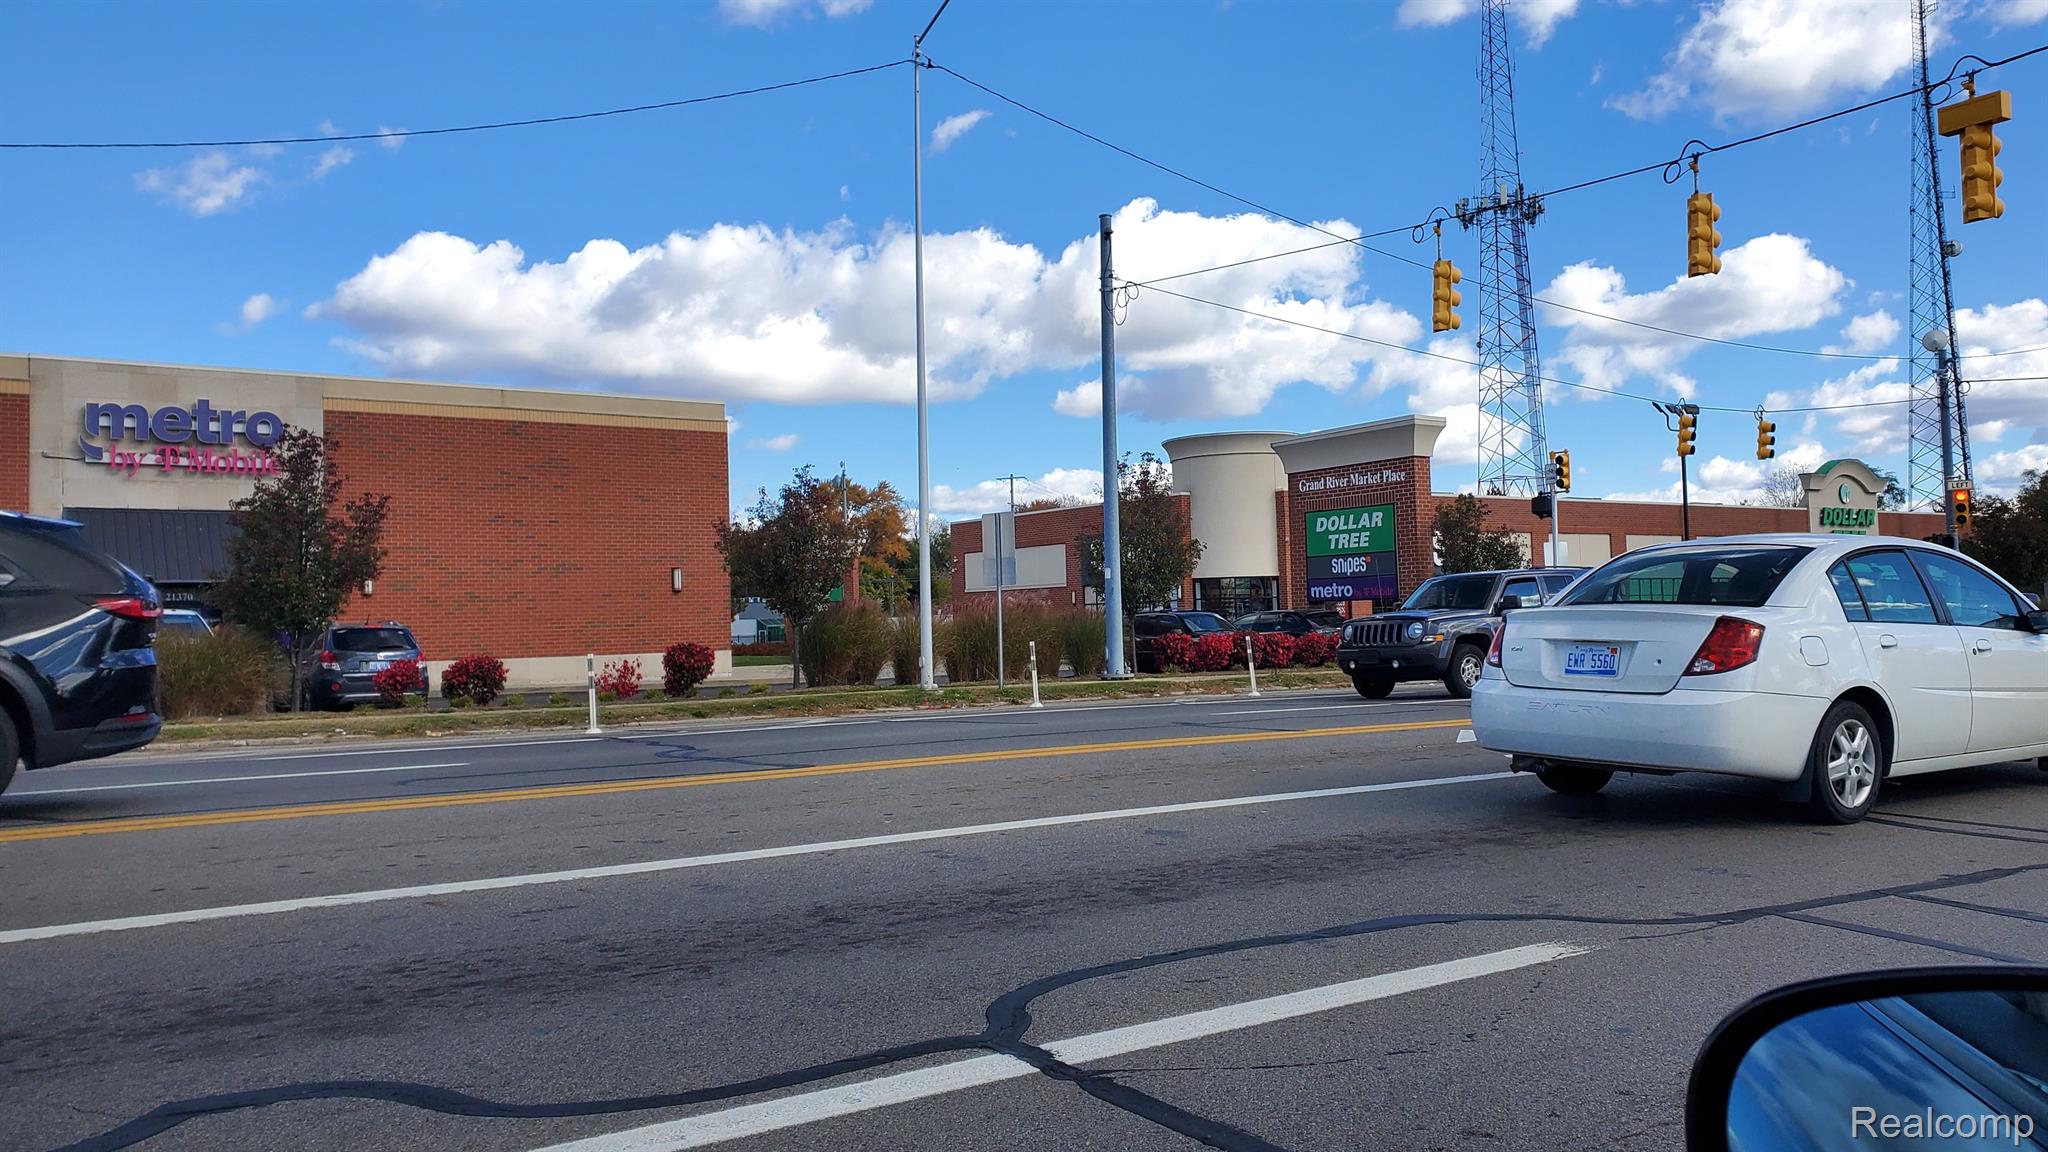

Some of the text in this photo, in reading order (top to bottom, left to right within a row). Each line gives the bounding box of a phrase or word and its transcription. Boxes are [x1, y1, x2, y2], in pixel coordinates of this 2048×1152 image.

[83, 398, 284, 447] metro
[109, 444, 148, 479] by
[1298, 469, 1406, 493] Grand River Market Place
[1951, 481, 1969, 489] LEFT
[1315, 511, 1383, 532] DOLLAR
[1822, 507, 1876, 527] DOLLAR
[1328, 531, 1371, 550] TREE
[1331, 556, 1367, 576] snipes
[165, 592, 194, 601] 21370
[1310, 582, 1353, 598] metro
[1567, 652, 1616, 669] EWR 5560
